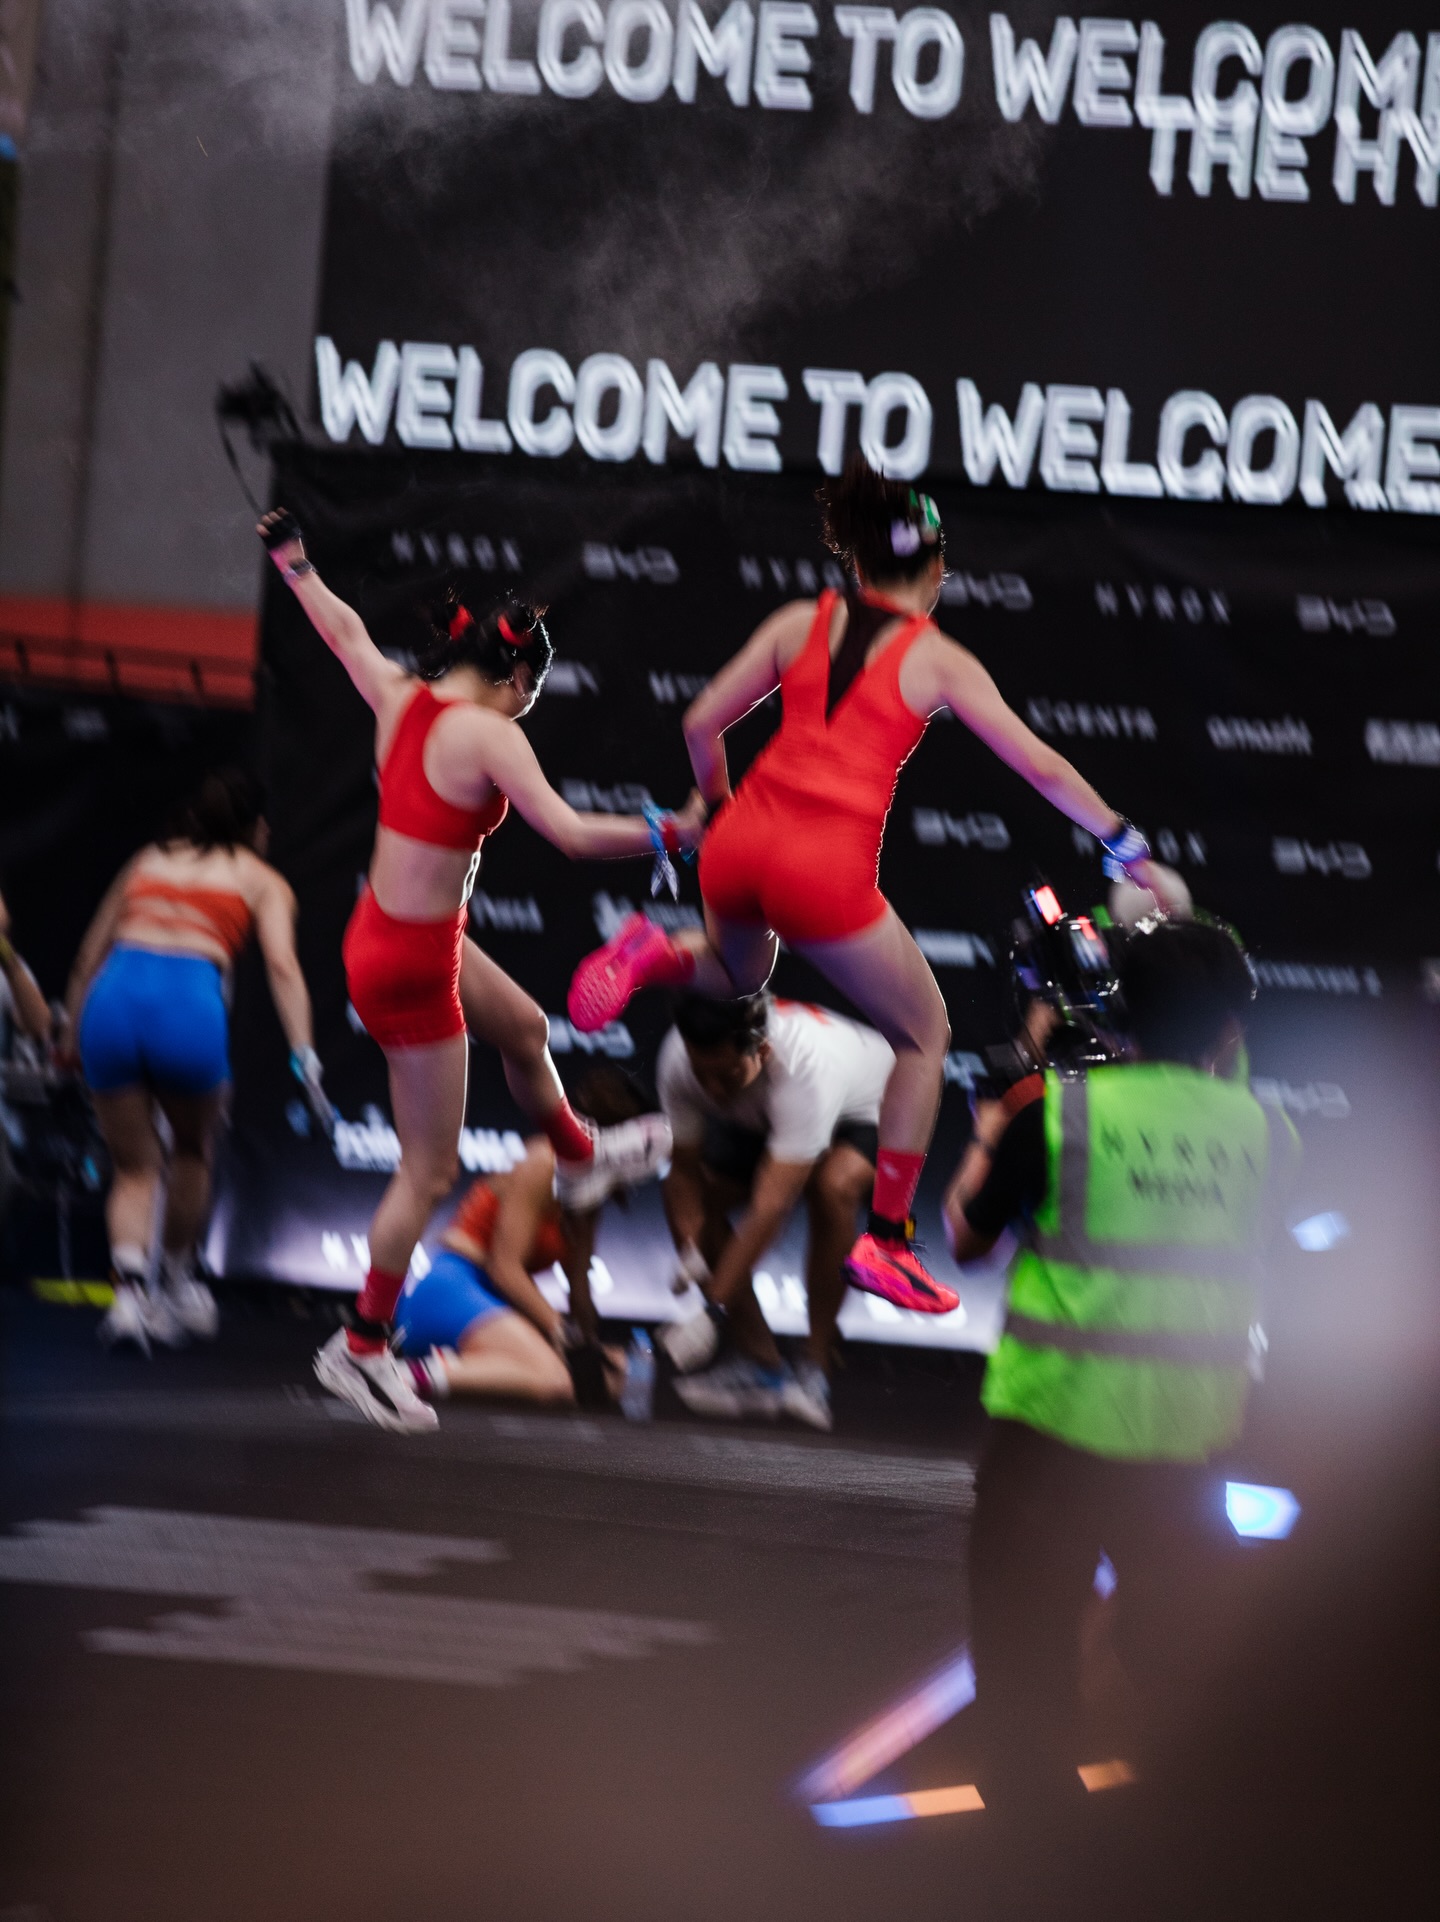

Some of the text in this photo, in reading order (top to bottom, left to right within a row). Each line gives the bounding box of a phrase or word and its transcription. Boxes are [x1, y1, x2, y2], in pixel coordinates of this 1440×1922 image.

[346, 0, 1440, 137] WELCOME TO WELCOM
[1138, 97, 1309, 202] THE
[314, 335, 1440, 513] WELCOME TO WELCOME
